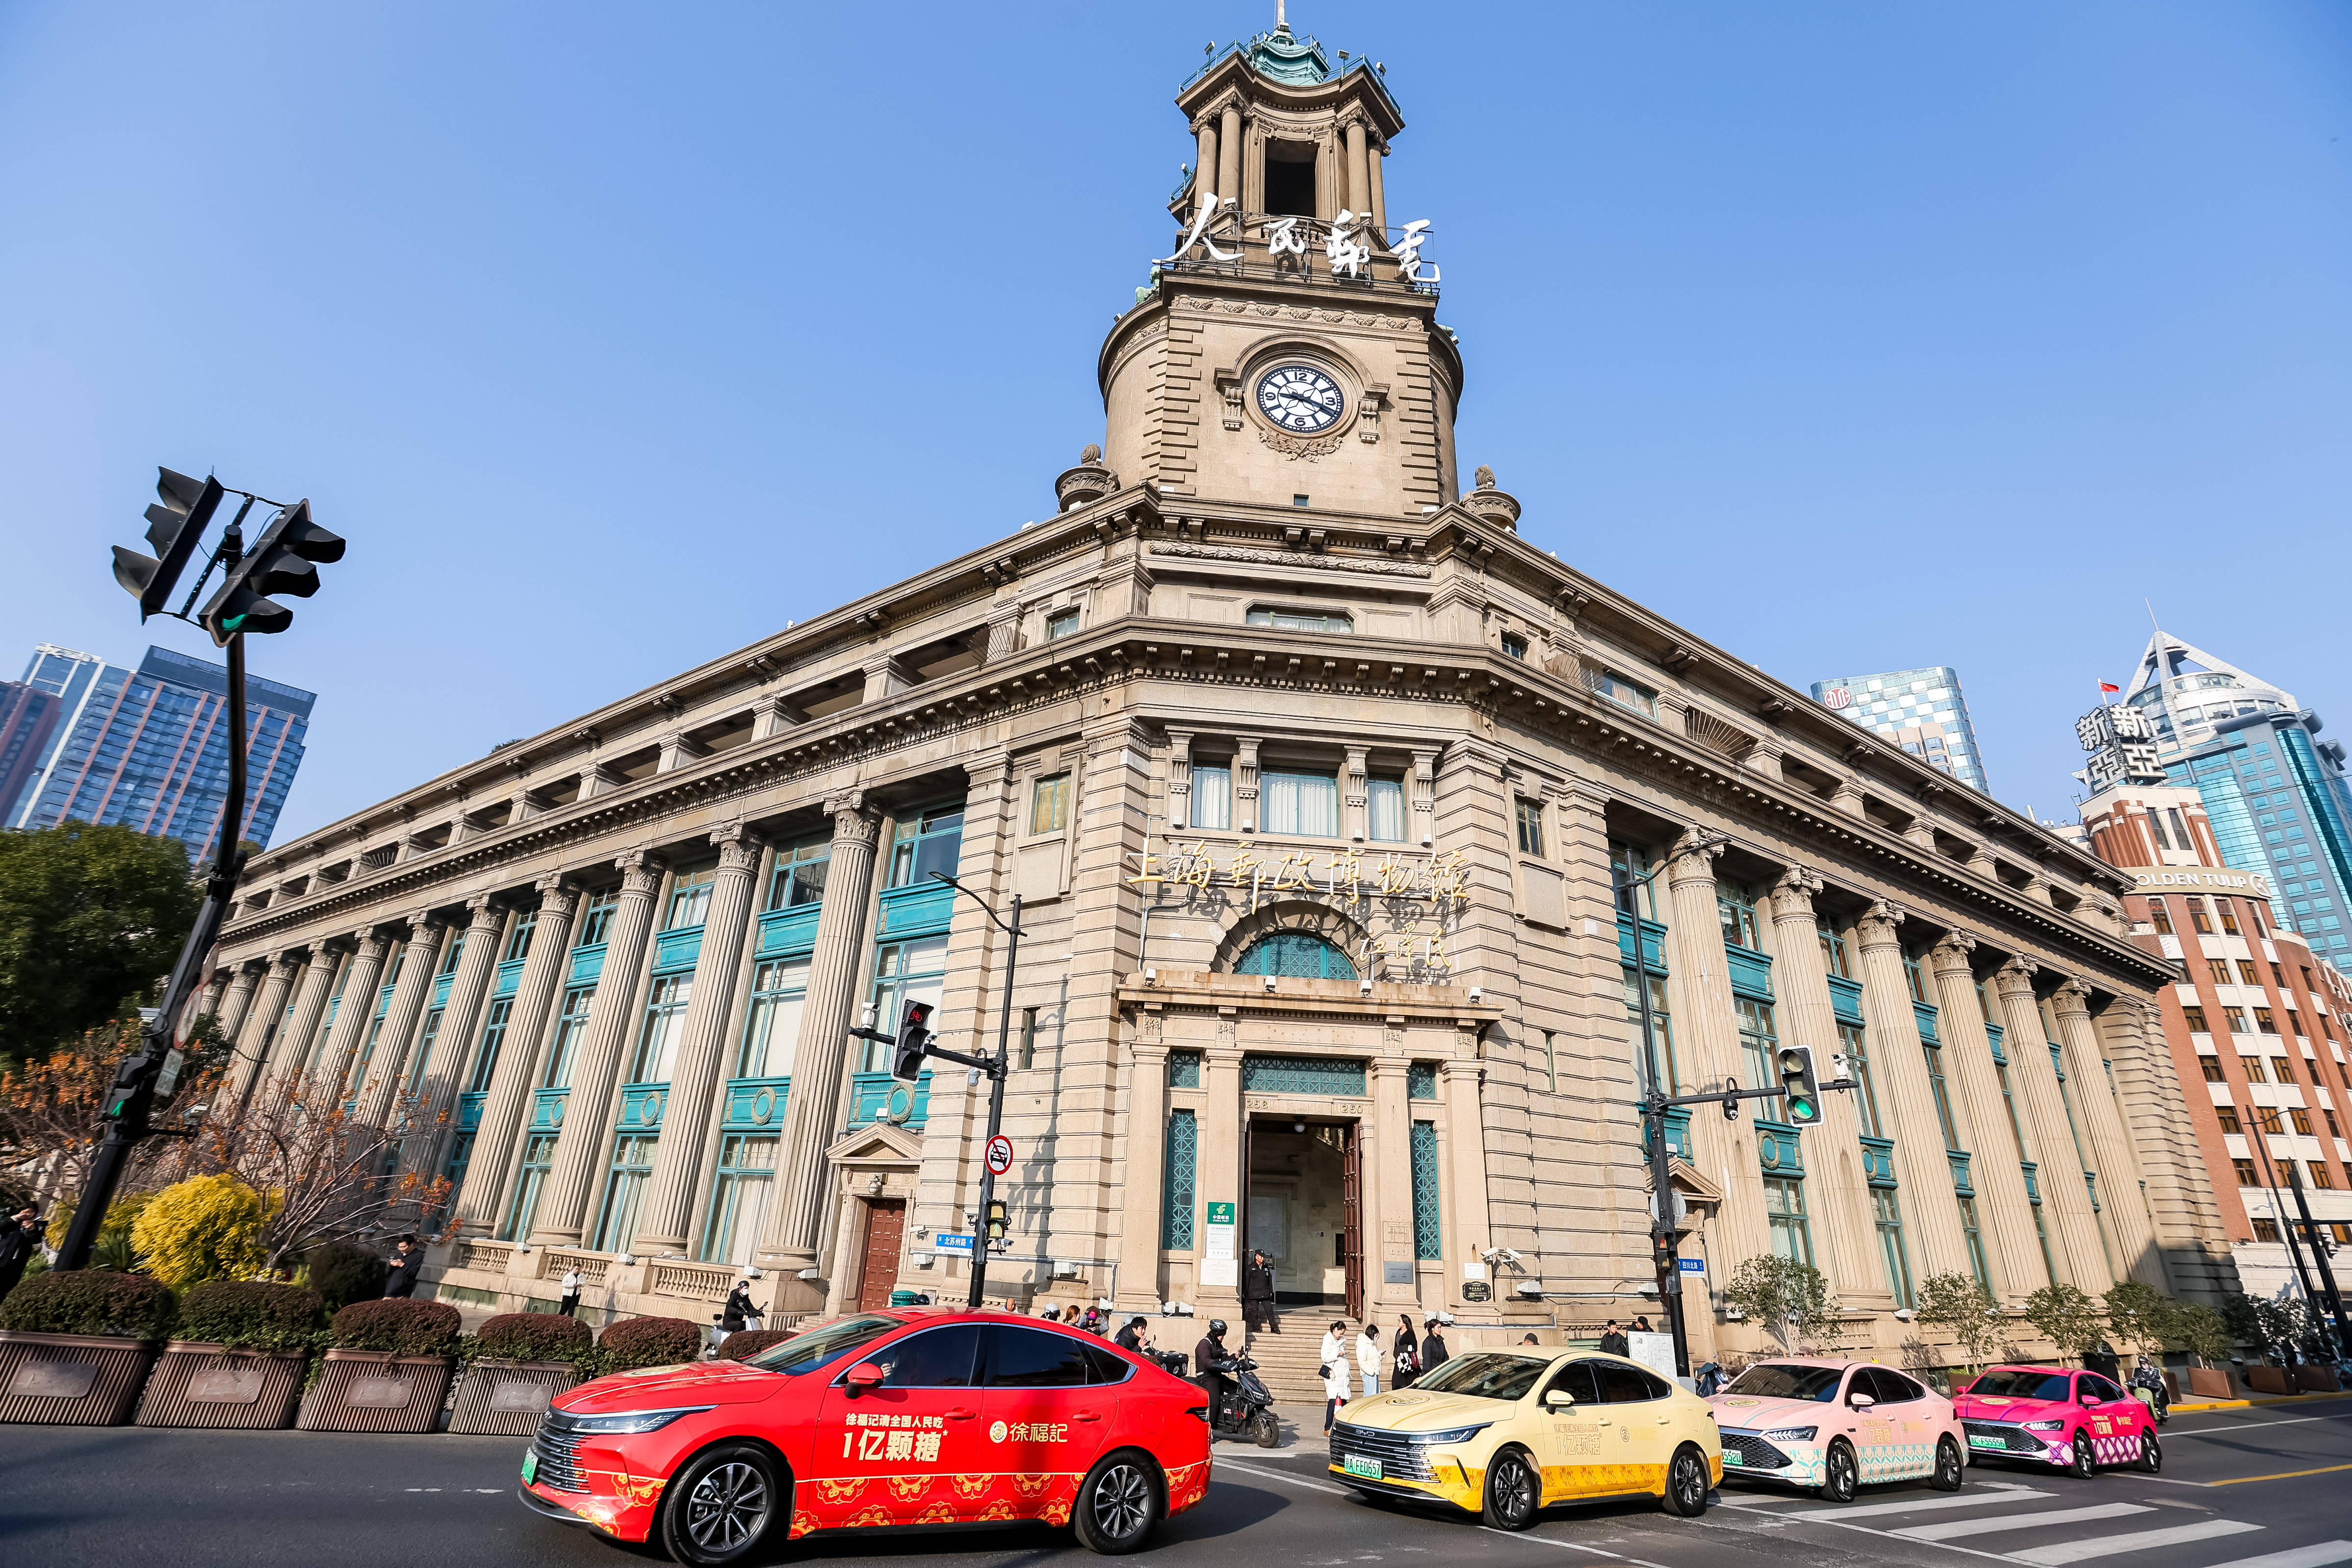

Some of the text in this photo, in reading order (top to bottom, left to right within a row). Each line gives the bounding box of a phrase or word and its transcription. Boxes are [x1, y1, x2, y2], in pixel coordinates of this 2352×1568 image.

[1294, 371, 1307, 381] 12
[1265, 392, 1276, 401] 9
[1325, 397, 1336, 406] 3
[1294, 417, 1306, 426] 6
[2134, 873, 2247, 888] OLDEN TULIP
[1247, 1099, 1268, 1109] 258
[1342, 1103, 1363, 1114] 250
[944, 1236, 966, 1247] 北苏州路
[845, 1413, 944, 1429] 徐福记请全国人民吃
[1009, 1422, 1068, 1443] 徐福記
